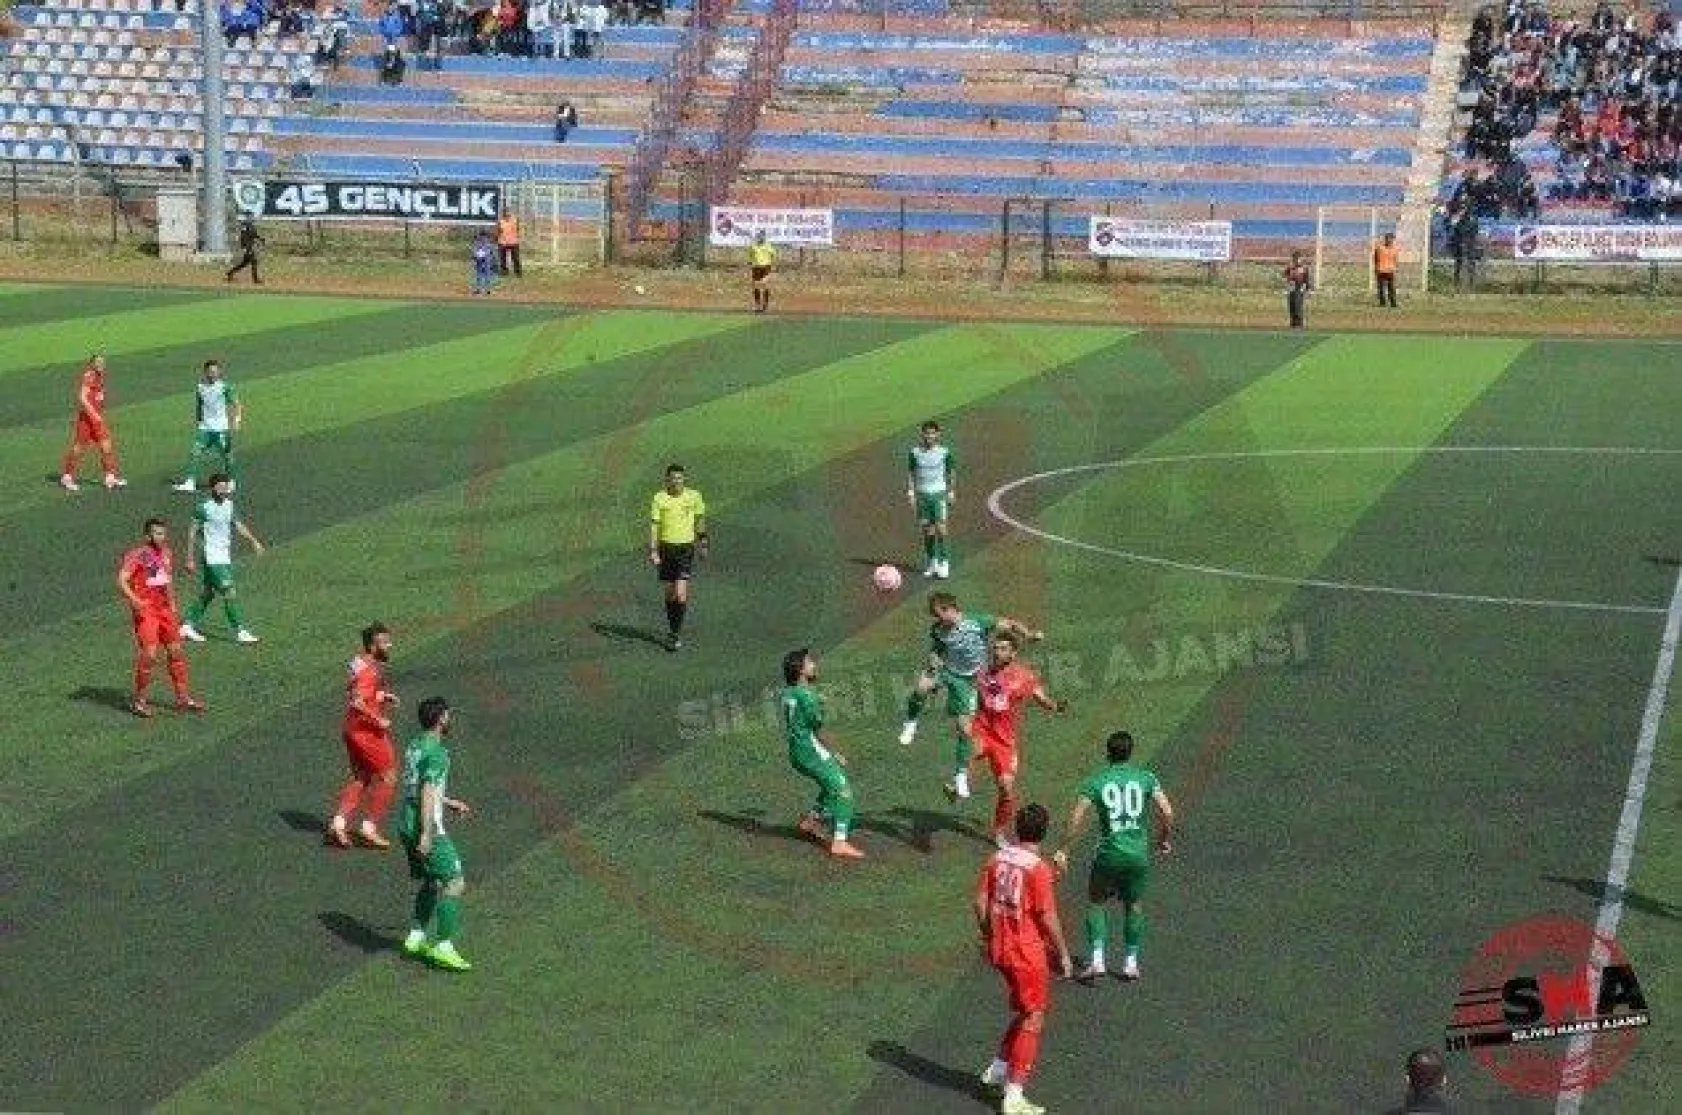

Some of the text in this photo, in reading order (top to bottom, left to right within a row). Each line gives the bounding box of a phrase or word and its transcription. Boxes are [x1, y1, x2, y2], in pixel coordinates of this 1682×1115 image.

[275, 184, 496, 220] 45 GENÇLİK
[1102, 781, 1143, 818] 90
